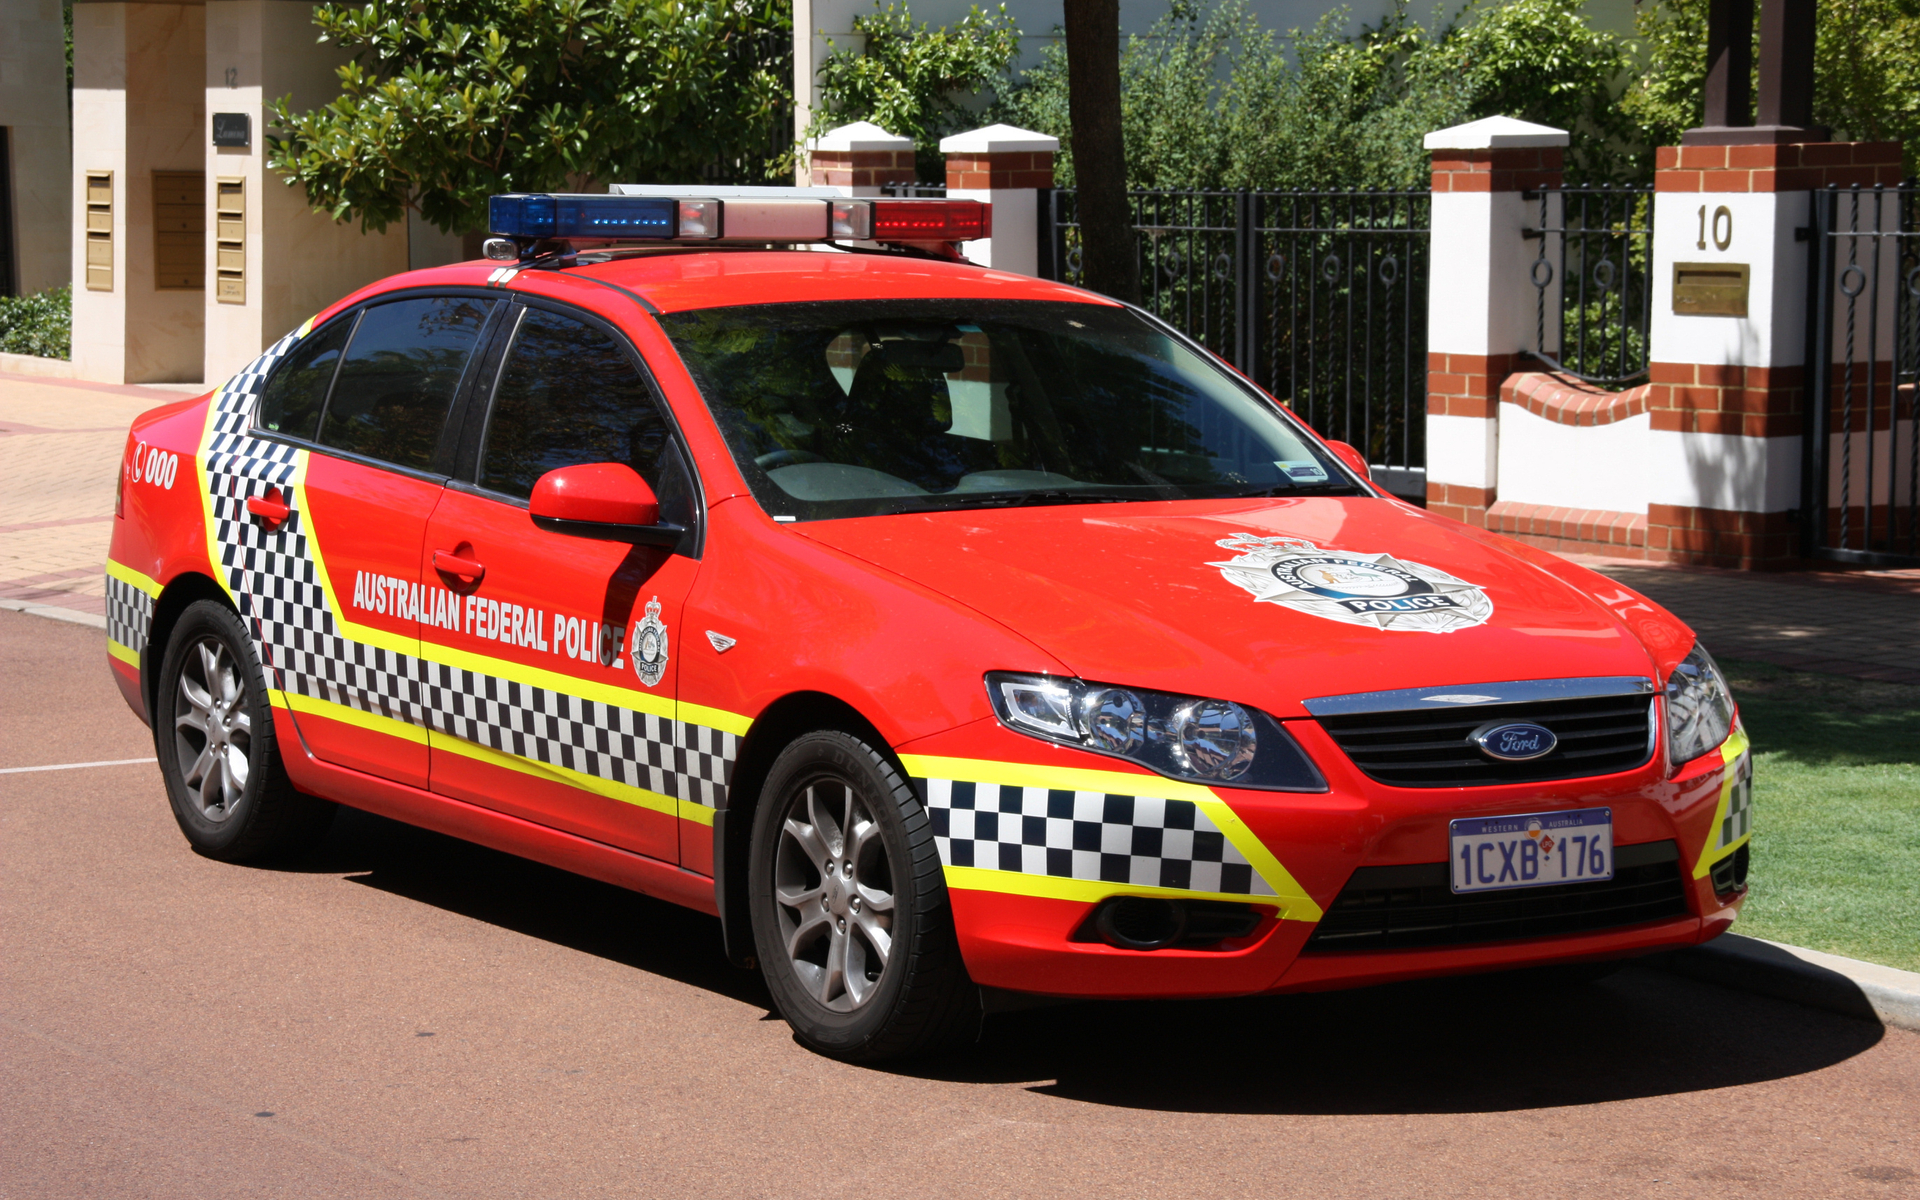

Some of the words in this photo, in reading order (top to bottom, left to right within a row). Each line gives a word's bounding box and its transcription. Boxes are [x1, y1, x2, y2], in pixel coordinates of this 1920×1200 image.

[224, 66, 239, 89] 12
[1696, 204, 1732, 252] 10
[145, 447, 178, 490] 000
[1276, 558, 1329, 590] AUSTRALIAN
[1333, 558, 1419, 583] FEDERAL
[1349, 596, 1451, 611] POLICE
[353, 570, 461, 632] AUSTRALIAN
[466, 595, 548, 652] FEDERAL
[553, 613, 624, 670] POLICE
[641, 662, 657, 672] POLICE
[1500, 730, 1540, 752] Ford
[831, 749, 897, 845] DUNLOP
[1481, 824, 1519, 834] WESTERN
[1548, 819, 1584, 828] AUSTRALIA
[1541, 840, 1554, 849] LPG
[1460, 838, 1539, 886] 1CXB
[1557, 833, 1605, 878] 176
